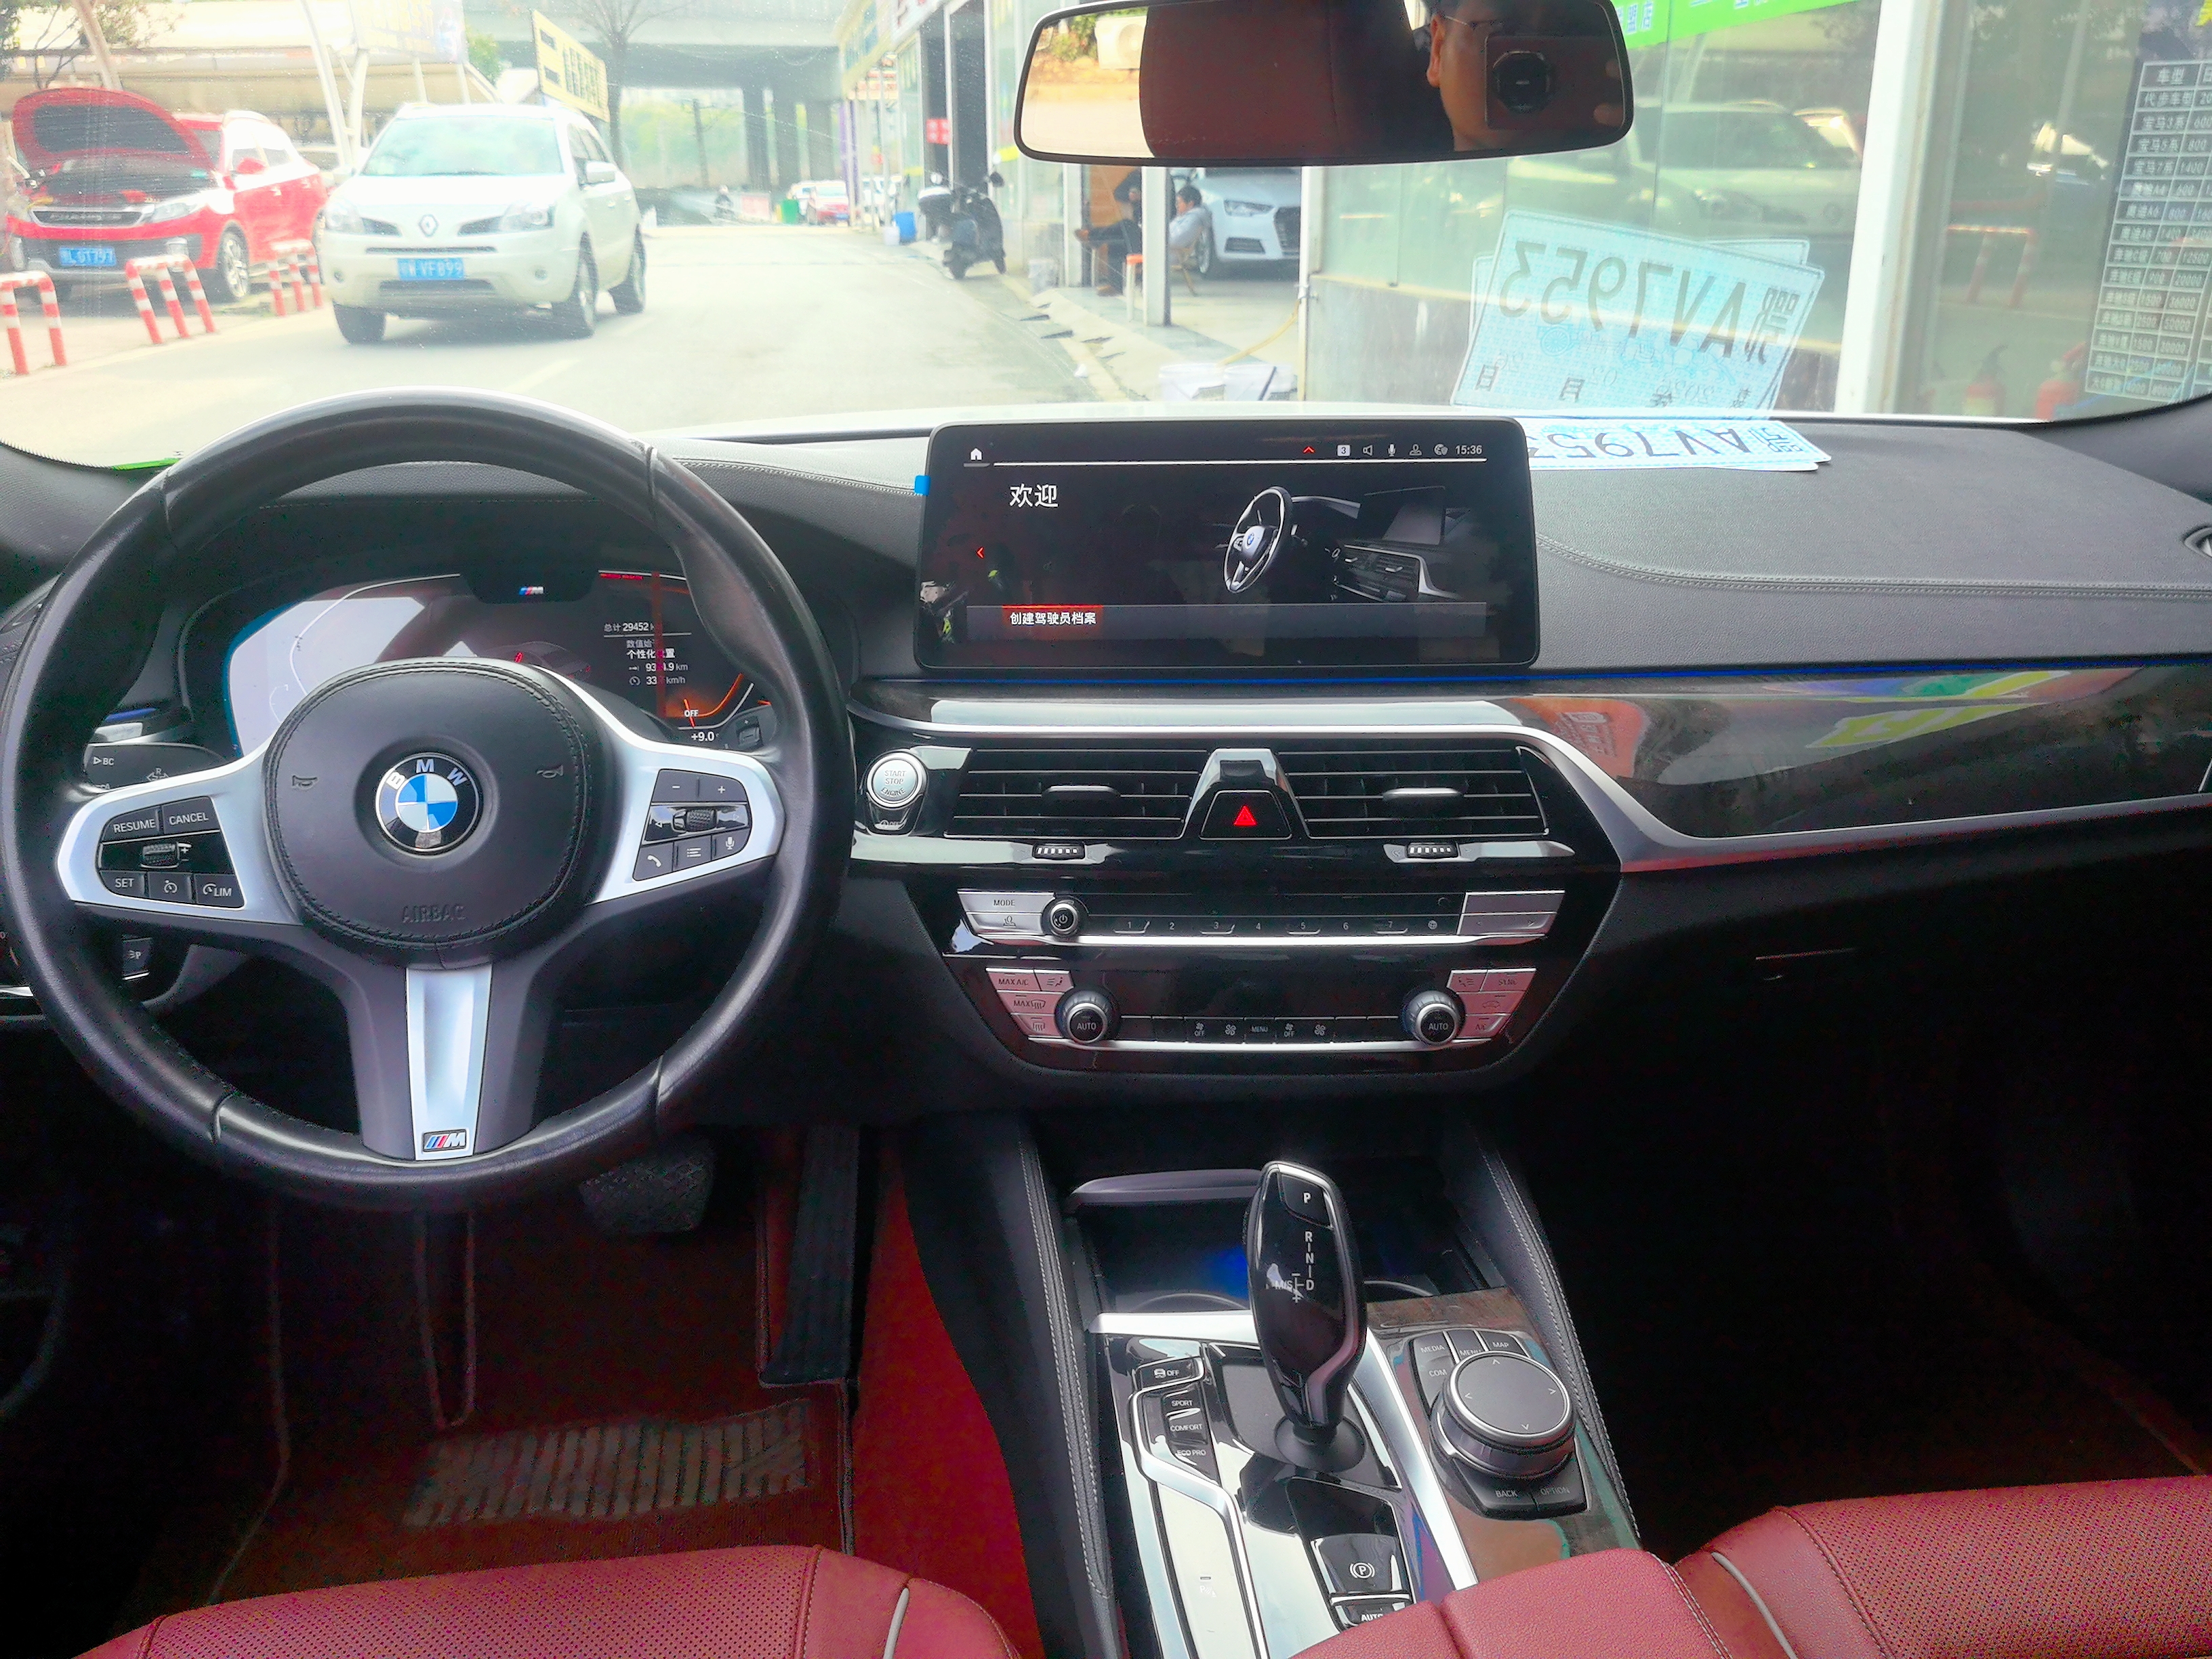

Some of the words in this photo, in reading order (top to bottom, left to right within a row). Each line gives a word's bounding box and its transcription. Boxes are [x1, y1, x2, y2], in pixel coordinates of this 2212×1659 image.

[1456, 445, 1483, 455] 15:36
[1010, 483, 1059, 508] 欢迎
[1010, 612, 1097, 625] 创建驾驶员档案
[604, 623, 621, 632] 总计
[622, 622, 649, 632] 29452
[626, 640, 655, 649] 数值始
[684, 710, 699, 718] OFF
[102, 758, 115, 766] BC
[386, 758, 468, 790] BMW
[880, 787, 906, 797] ENGINE
[113, 819, 157, 834] RESUME
[169, 812, 209, 825] CANCEL
[115, 878, 135, 888] SET
[213, 887, 232, 897] LIM
[1013, 1000, 1030, 1008] MAX
[1077, 1022, 1097, 1031] AUTO
[1428, 1022, 1449, 1031] AUTO
[1303, 1192, 1312, 1204] P
[1305, 1231, 1313, 1243] R
[1305, 1252, 1315, 1265] N
[1306, 1279, 1315, 1291] D
[1420, 1344, 1446, 1353] MEDIA
[1429, 1369, 1448, 1377] COM
[1170, 1423, 1203, 1432] COMFORT
[1495, 1490, 1518, 1498] BACK
[1540, 1486, 1571, 1496] OPTION
